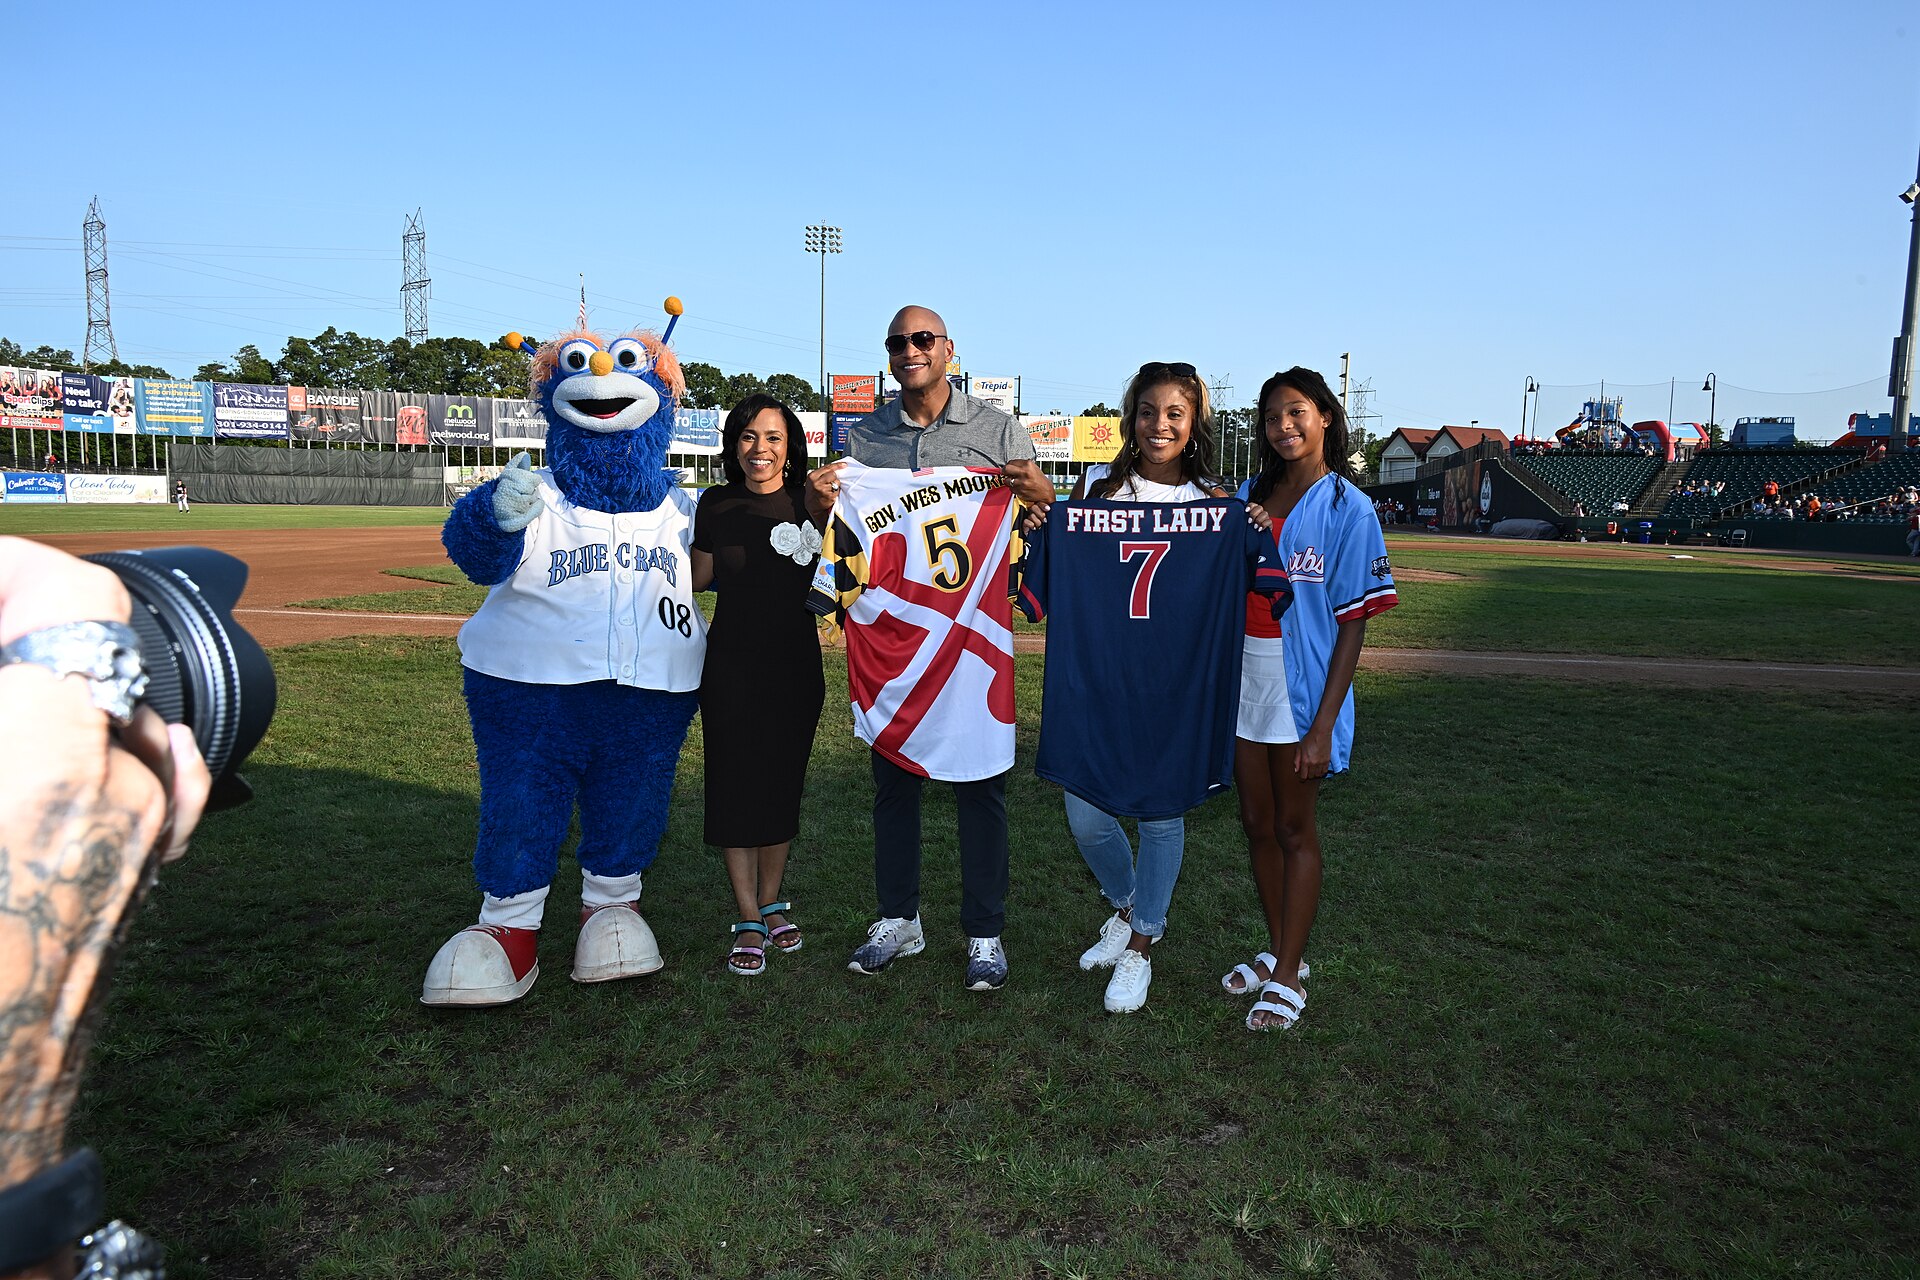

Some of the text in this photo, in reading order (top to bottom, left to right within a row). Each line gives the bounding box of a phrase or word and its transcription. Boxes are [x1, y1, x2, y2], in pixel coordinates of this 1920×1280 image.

[65, 387, 91, 397] Need
[65, 398, 103, 409] to talk?
[306, 394, 360, 407] BAYSIDE
[1, 417, 10, 425] 6
[675, 413, 718, 429] roflex
[432, 430, 490, 441] melwood.org
[1036, 451, 1070, 459] 820-7604
[7, 477, 38, 489] Calvert
[69, 477, 136, 494] Clean Today
[865, 503, 902, 533] GOV.
[899, 485, 941, 513] WES
[1067, 507, 1227, 534] FIRST LADY
[920, 513, 973, 593] 5
[547, 543, 609, 588] BLUE
[1119, 541, 1171, 620] 7
[658, 596, 692, 638] 08
